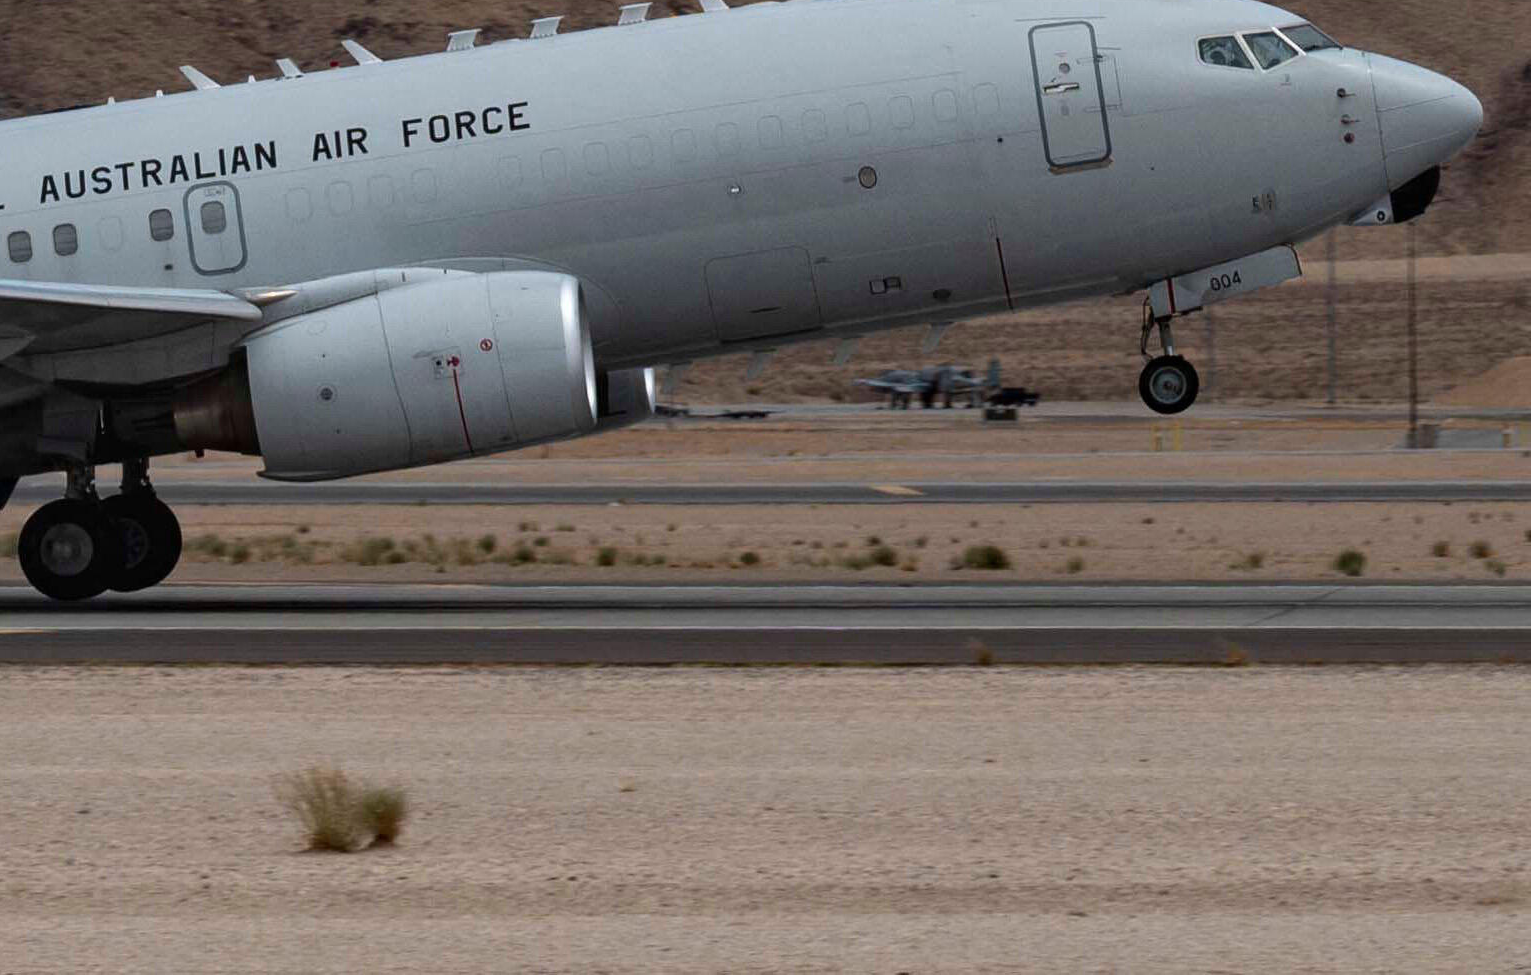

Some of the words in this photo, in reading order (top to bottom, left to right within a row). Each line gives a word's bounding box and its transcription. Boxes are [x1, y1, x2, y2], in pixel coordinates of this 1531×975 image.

[39, 140, 278, 204] AUSTRALIAN
[312, 127, 369, 162] AIR
[402, 101, 532, 148] FORCE
[1209, 270, 1242, 292] 004
